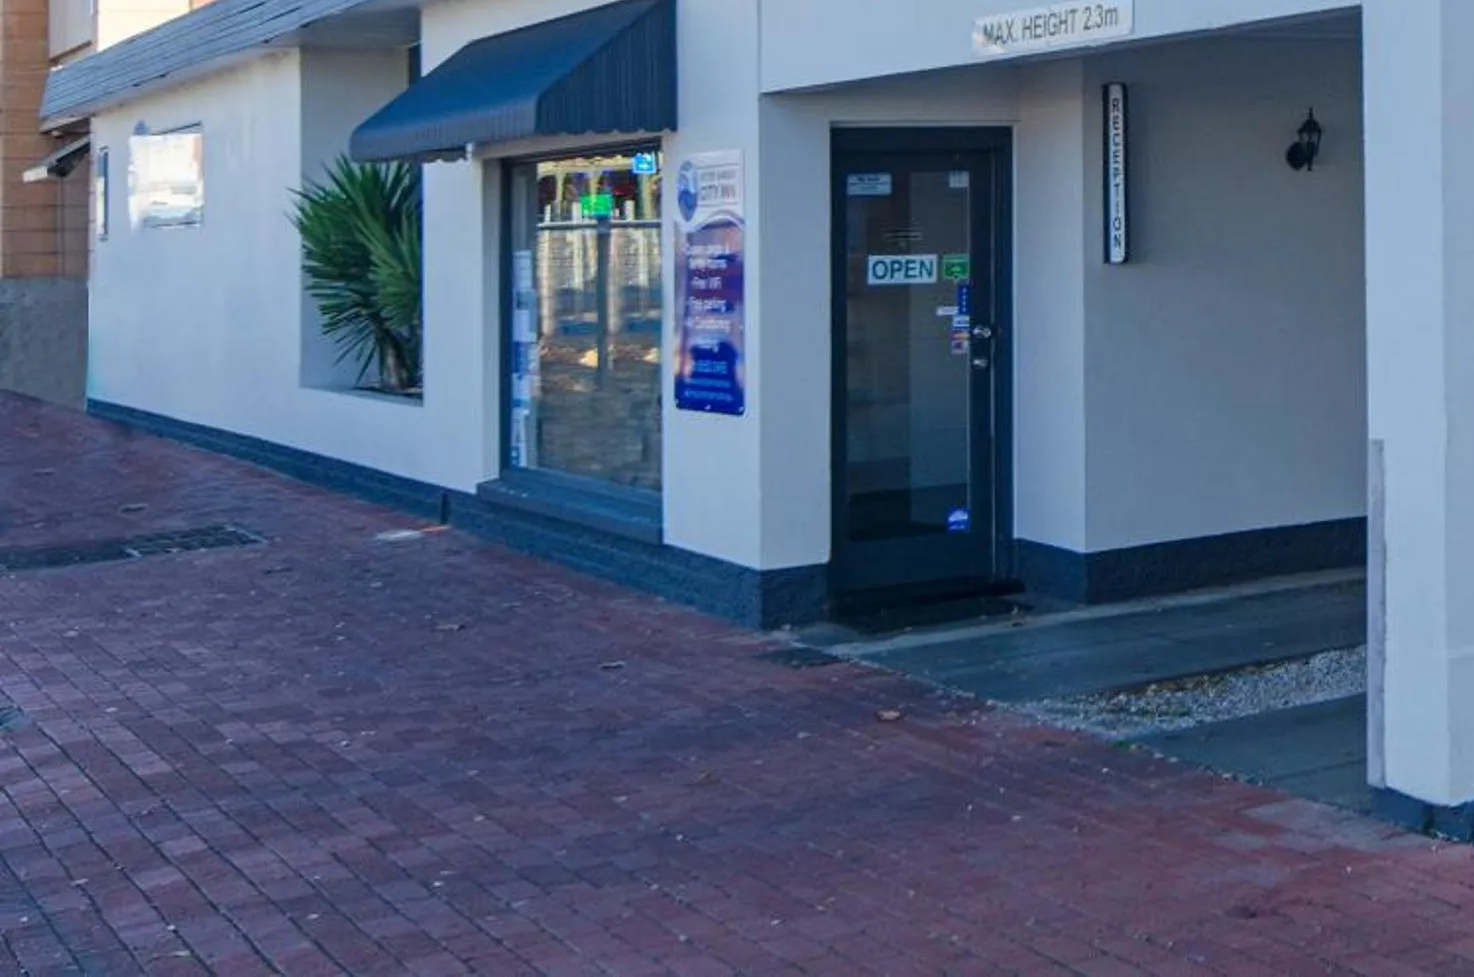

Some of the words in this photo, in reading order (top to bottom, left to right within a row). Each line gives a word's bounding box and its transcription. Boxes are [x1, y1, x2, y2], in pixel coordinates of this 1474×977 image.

[1022, 8, 1079, 40] HEIGHT
[1112, 97, 1123, 249] RECEPTION
[871, 258, 934, 281] OPEN
